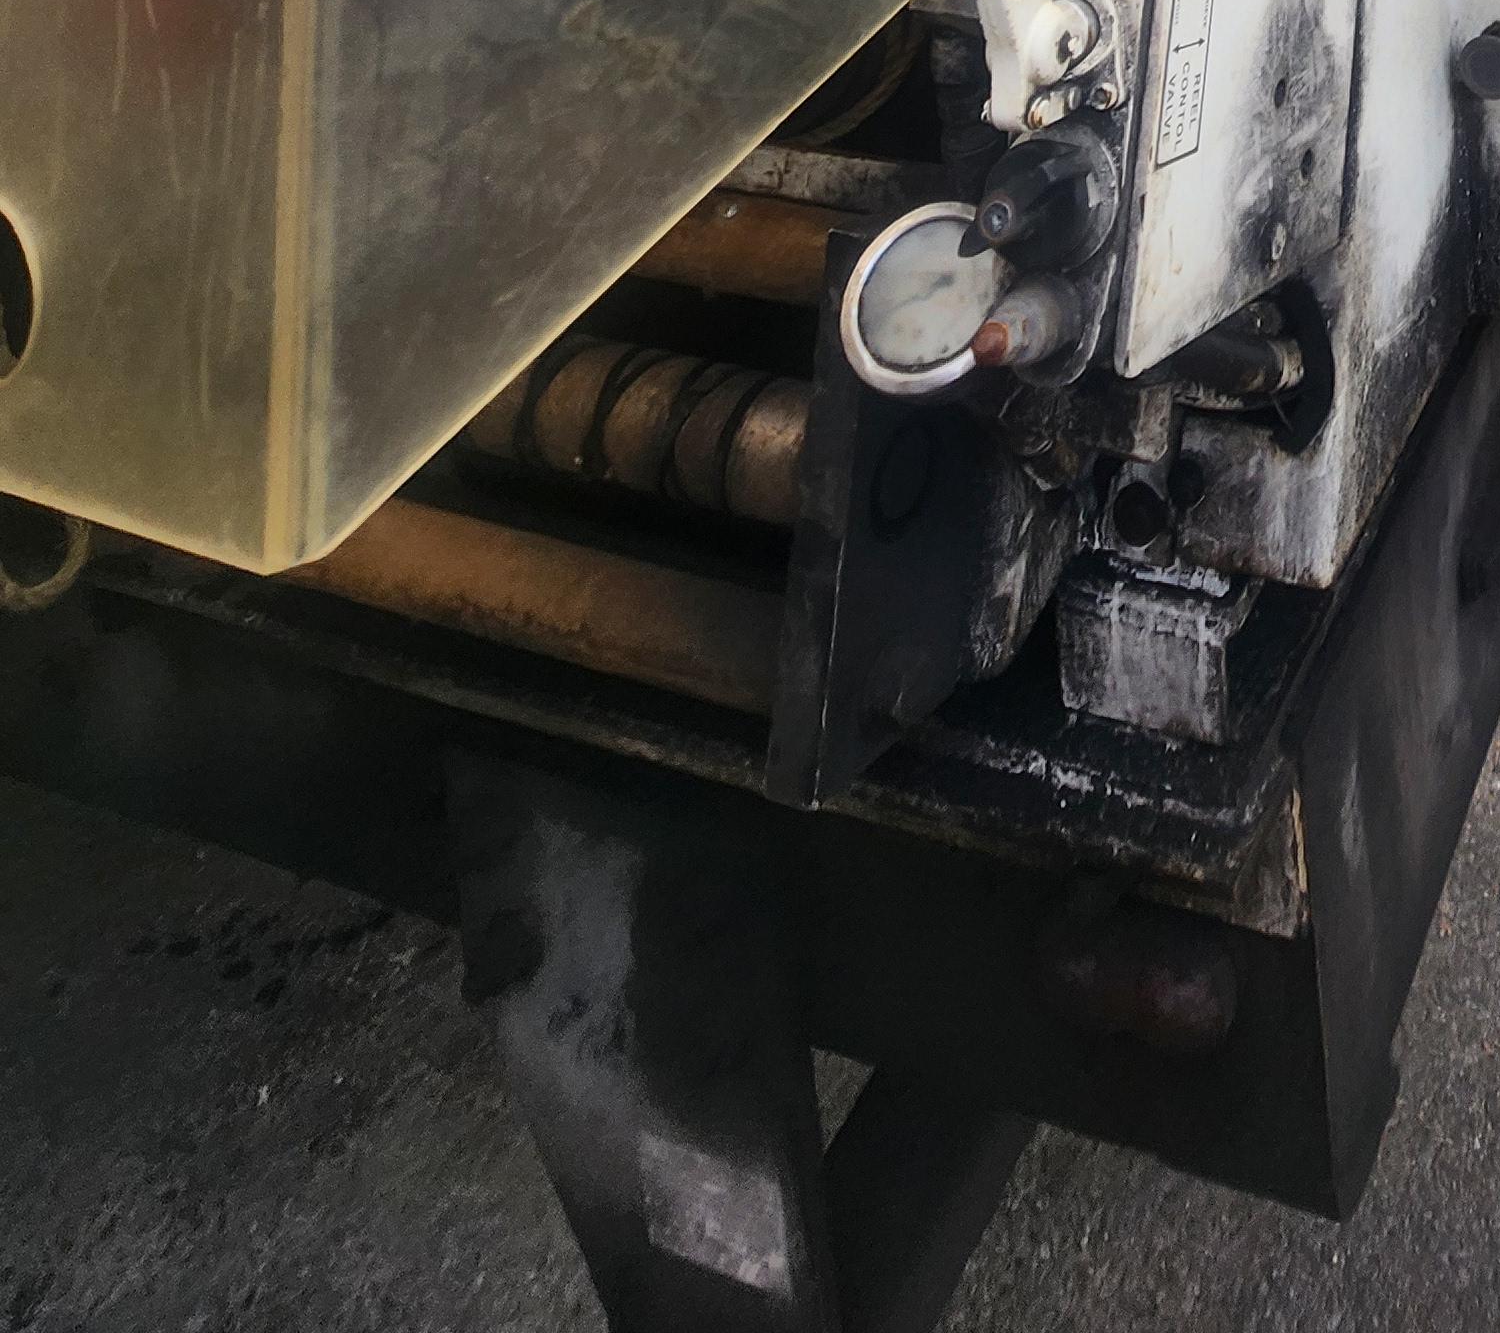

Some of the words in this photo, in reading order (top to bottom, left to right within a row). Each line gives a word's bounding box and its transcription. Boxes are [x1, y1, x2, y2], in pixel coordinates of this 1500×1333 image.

[1162, 73, 1177, 143] VALVE
[1174, 61, 1191, 152] CONTOL
[1188, 73, 1202, 131] REEL
